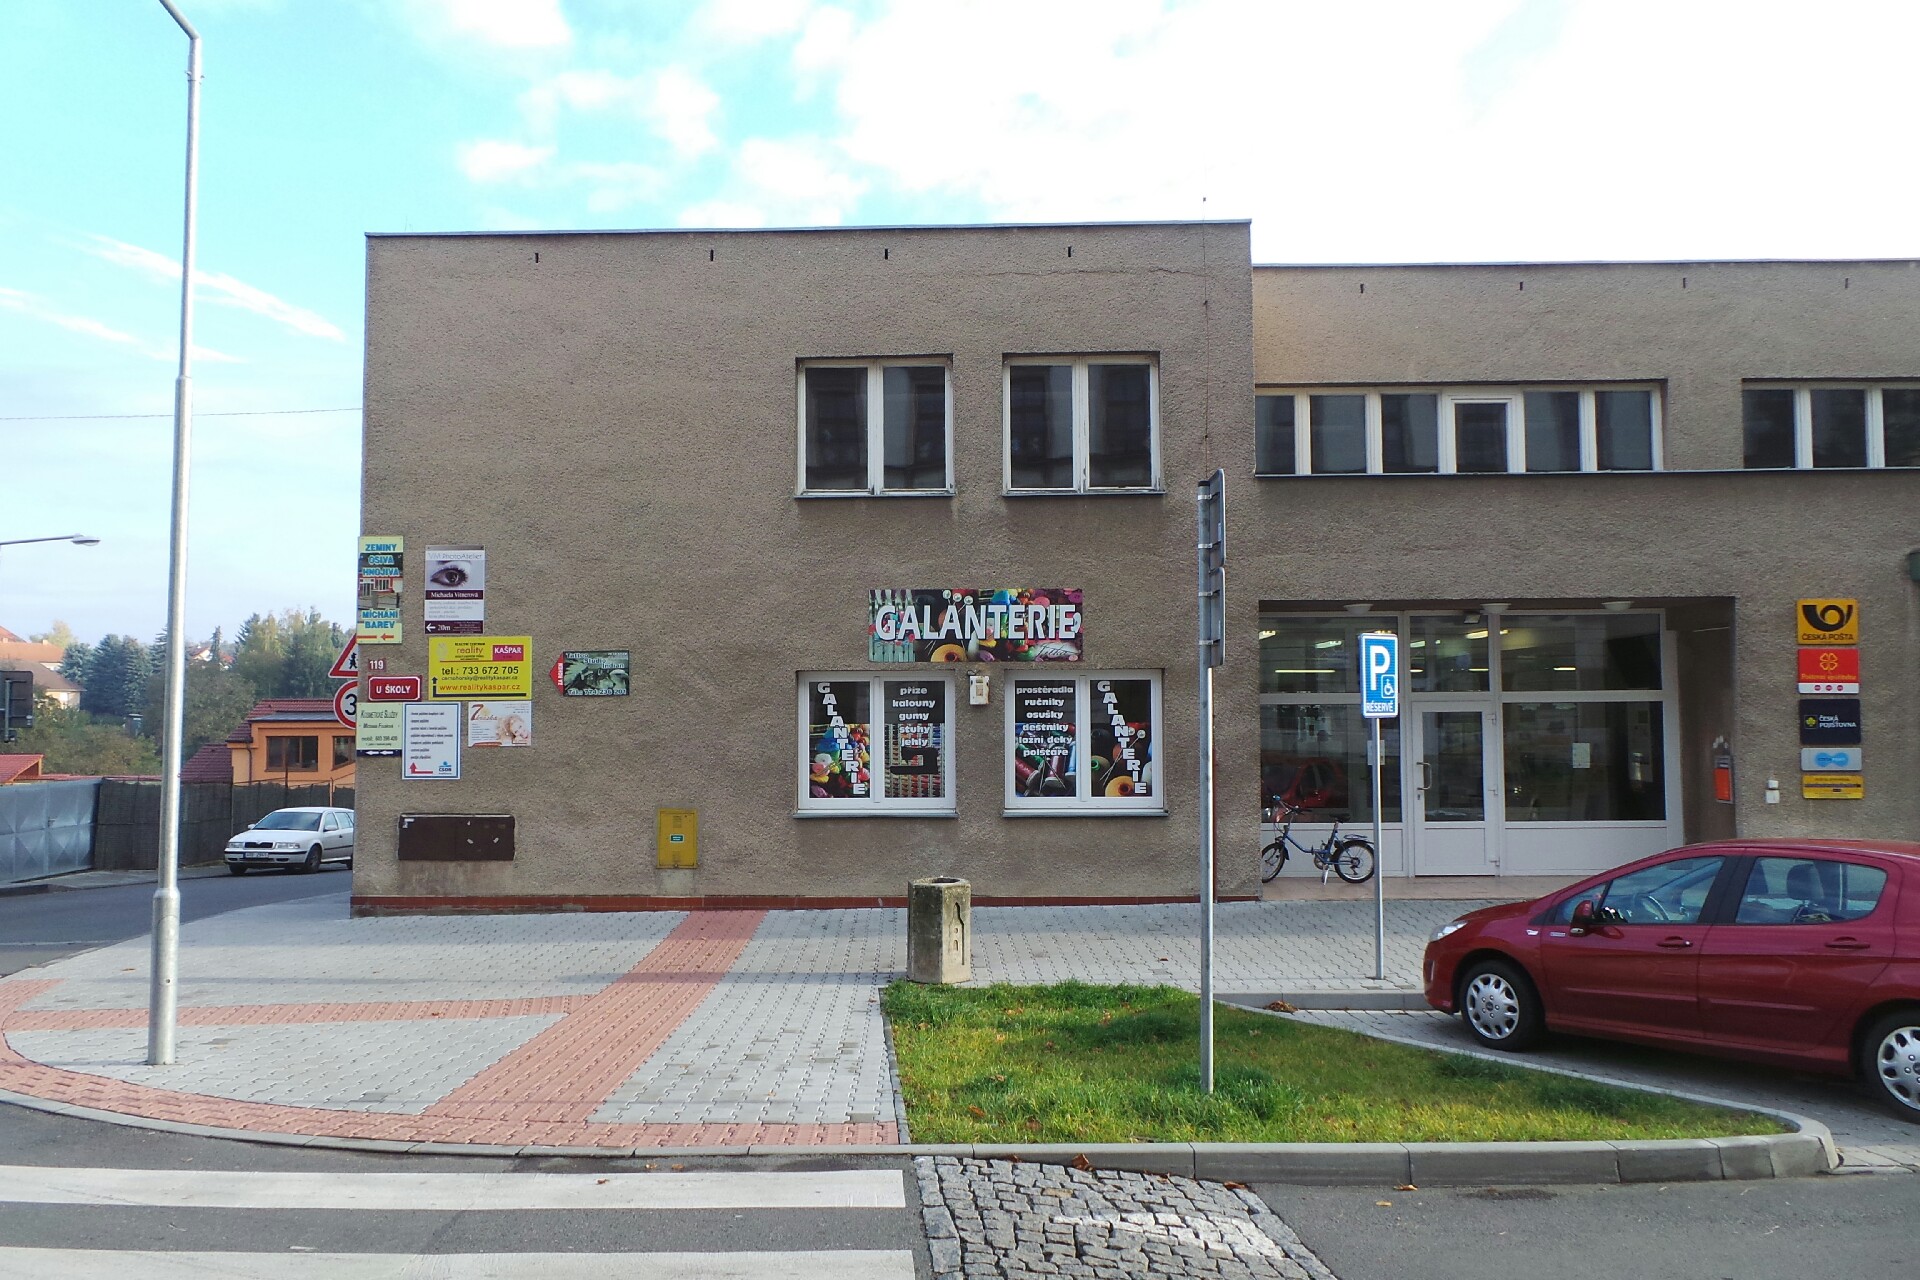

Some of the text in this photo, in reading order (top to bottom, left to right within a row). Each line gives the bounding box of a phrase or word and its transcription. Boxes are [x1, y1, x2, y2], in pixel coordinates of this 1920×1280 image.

[365, 543, 397, 552] ZEMINY
[368, 555, 395, 565] OSIVA
[362, 567, 399, 576] HNOJIVA
[364, 621, 395, 629] BAREV
[875, 604, 1077, 640] GALANTERIE
[1801, 633, 1854, 641] ČESKÁ POŠTA
[456, 646, 483, 655] reality
[494, 646, 522, 654] KAŠPAR
[369, 660, 384, 670] 119
[1369, 645, 1391, 691] P
[441, 666, 519, 675] tel.: 733 672 705
[376, 684, 411, 694] U ŠKOLY
[440, 684, 521, 692] www.realitykaspar.cz
[1016, 685, 1074, 695] prostěradla
[344, 693, 357, 716] 3
[892, 699, 936, 709] kalouny
[898, 712, 930, 721] gumy
[1026, 709, 1064, 719] osušky
[899, 725, 930, 734] stuhy
[817, 682, 866, 795] GALANTERIE
[901, 737, 929, 747] jehly
[1046, 735, 1073, 745] deky
[1097, 680, 1147, 794] GALANTERIE
